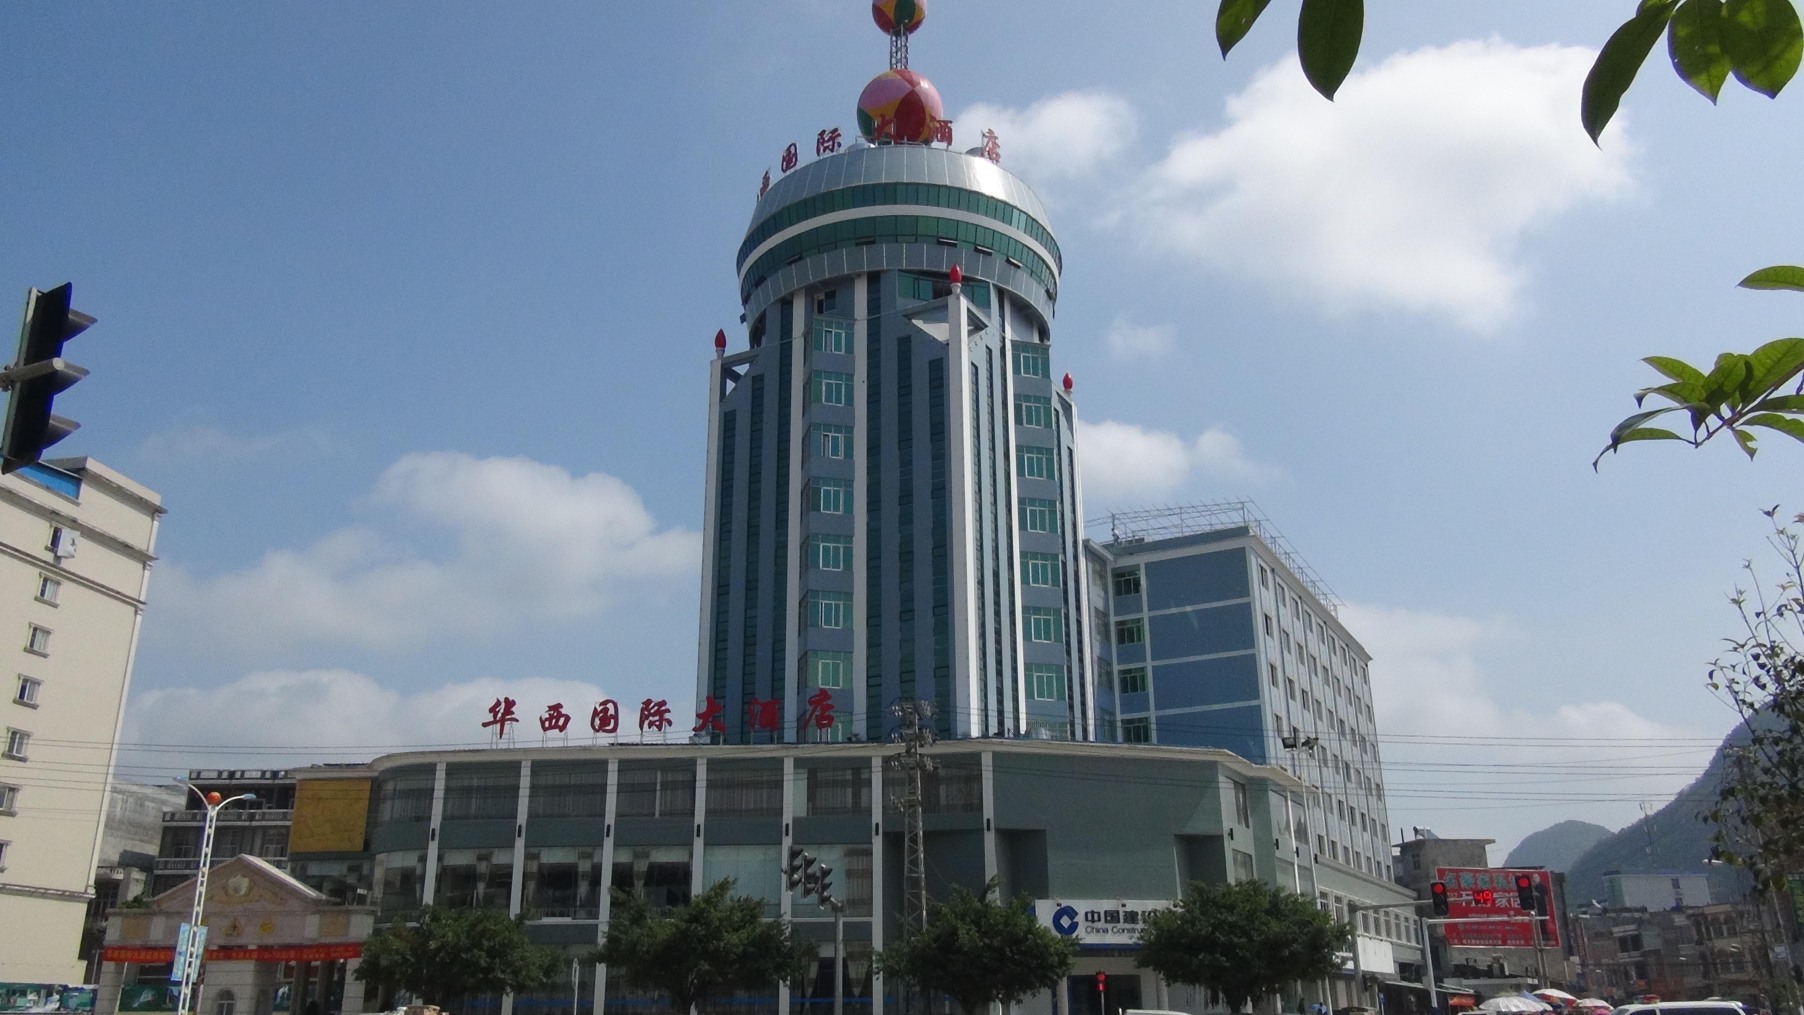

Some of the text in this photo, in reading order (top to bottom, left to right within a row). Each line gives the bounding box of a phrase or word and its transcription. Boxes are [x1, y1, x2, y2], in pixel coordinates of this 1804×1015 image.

[482, 688, 835, 739] 华西国际大酒店
[1085, 925, 1108, 934] China
